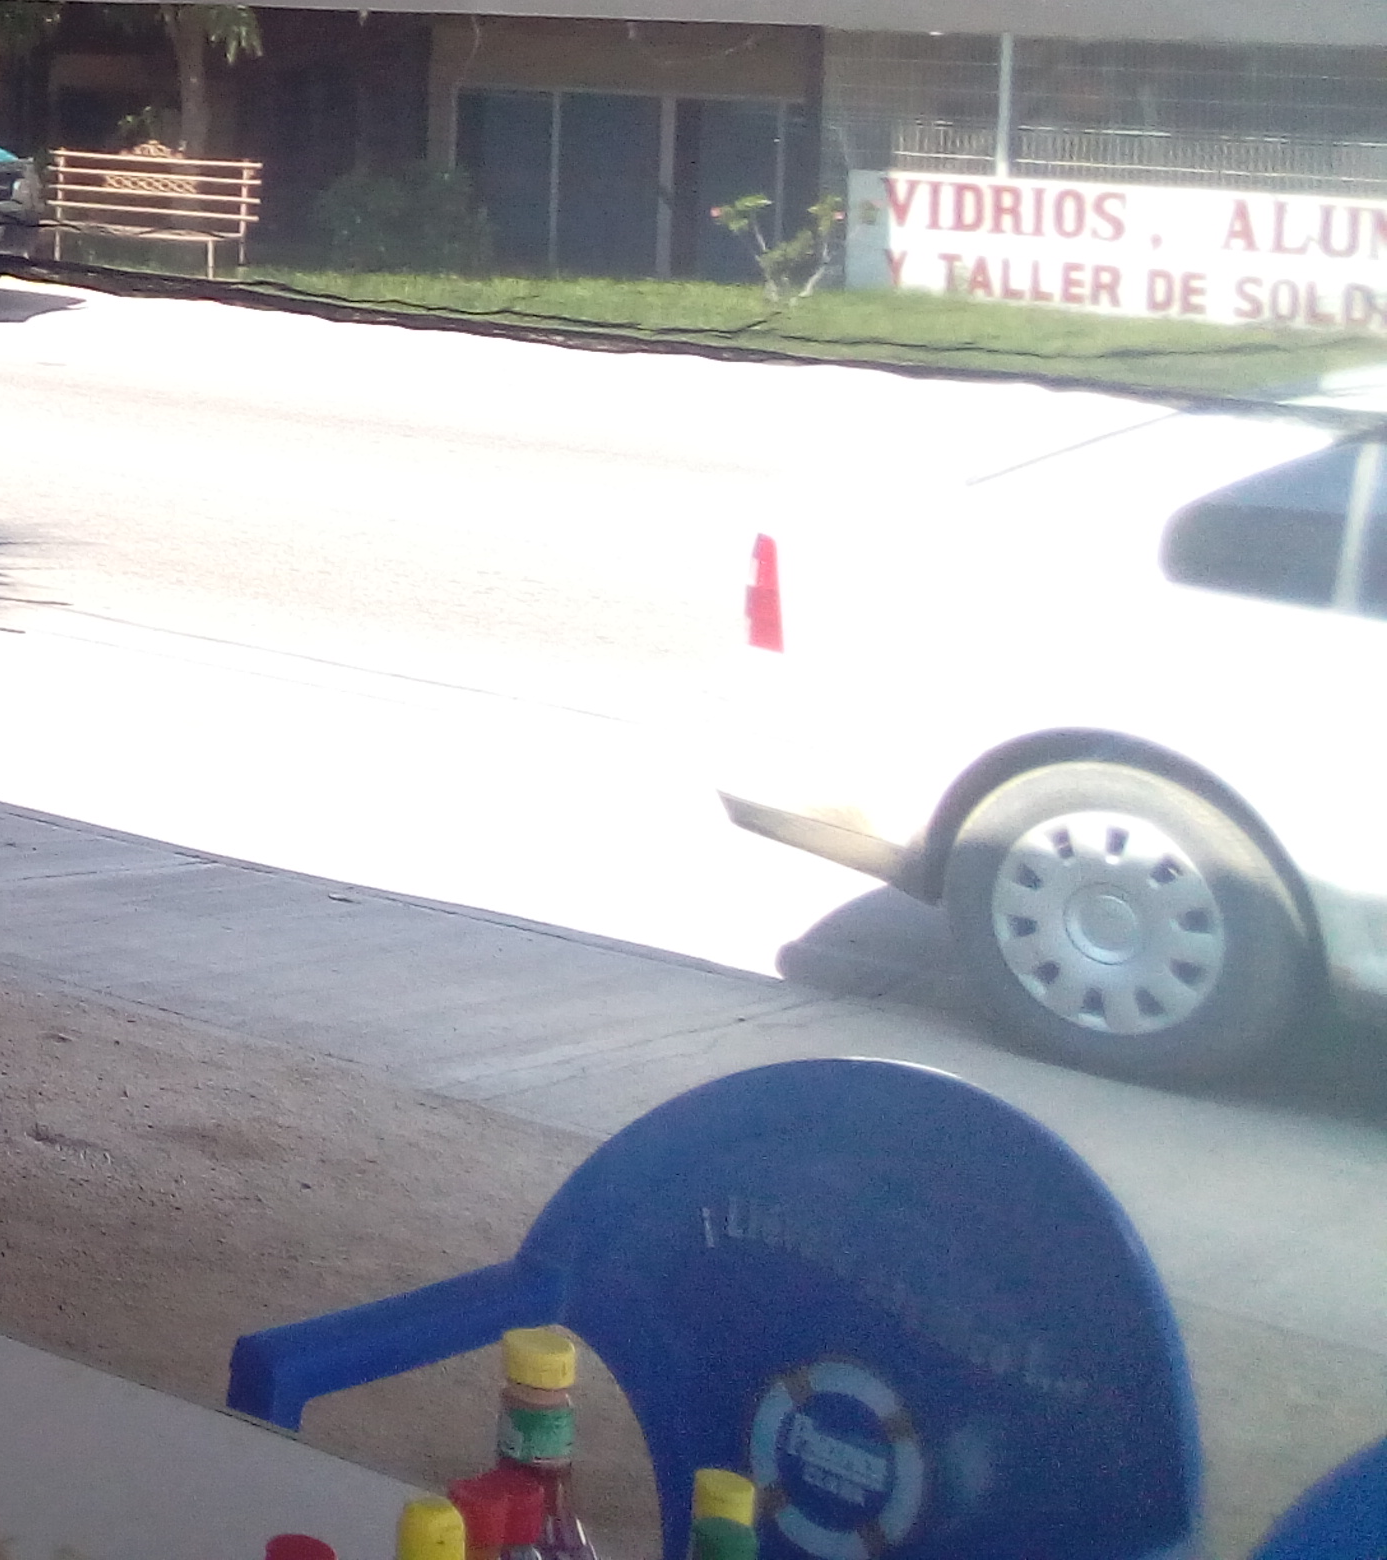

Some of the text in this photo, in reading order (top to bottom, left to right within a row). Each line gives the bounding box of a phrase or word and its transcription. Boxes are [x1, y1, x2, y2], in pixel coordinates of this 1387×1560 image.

[937, 252, 1122, 308] TALLER
[1146, 267, 1208, 316] DE
[1232, 275, 1387, 328] SOLD
